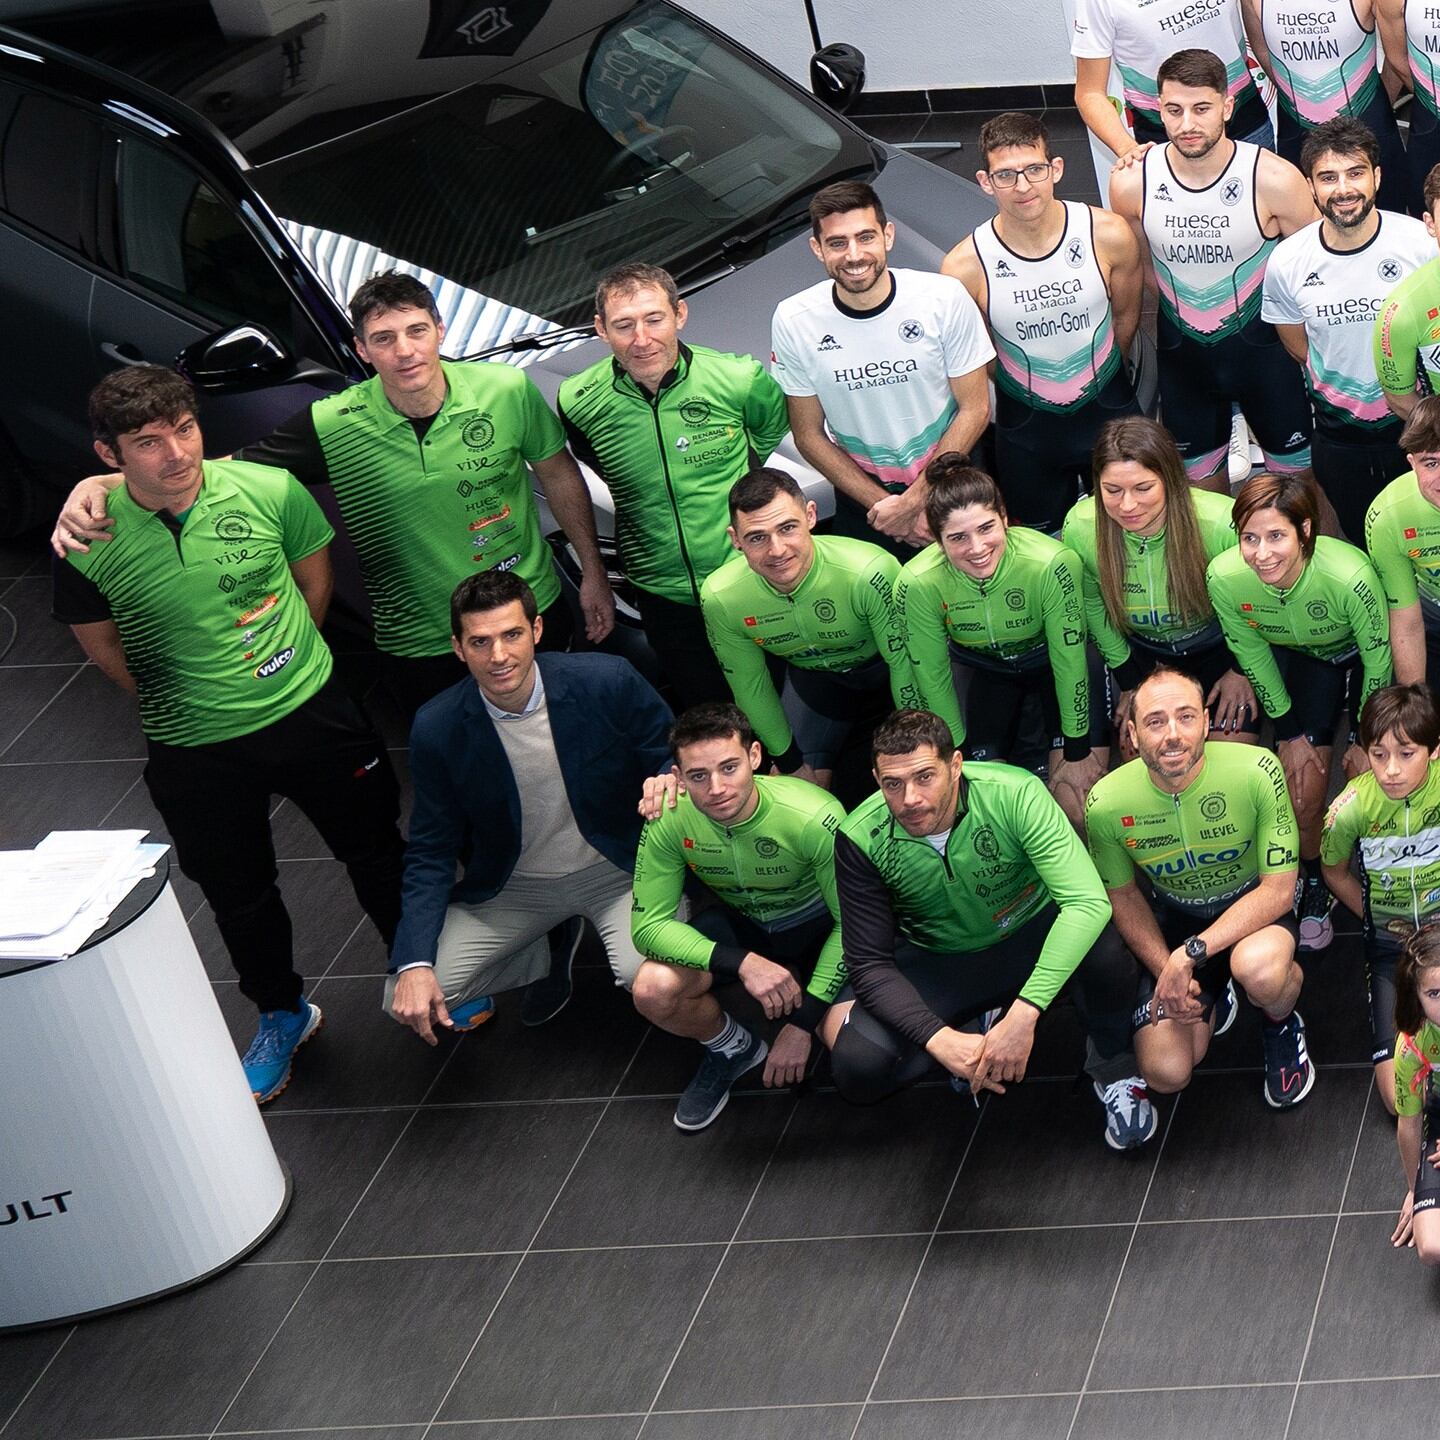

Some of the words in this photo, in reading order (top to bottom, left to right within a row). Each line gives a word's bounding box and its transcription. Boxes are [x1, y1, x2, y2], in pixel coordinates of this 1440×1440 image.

[1275, 10, 1338, 28] Huesca
[1280, 35, 1341, 62] ROMÁN
[1163, 211, 1231, 230] Huesca
[1161, 241, 1234, 266] LACAMBRA
[1012, 276, 1084, 305] Huesca
[833, 357, 919, 384] Huesca
[213, 547, 263, 567] vive
[257, 649, 293, 678] vulco
[1072, 677, 1089, 733] Huesca
[1200, 822, 1240, 841] ULEVEL
[1144, 848, 1240, 879] vulco
